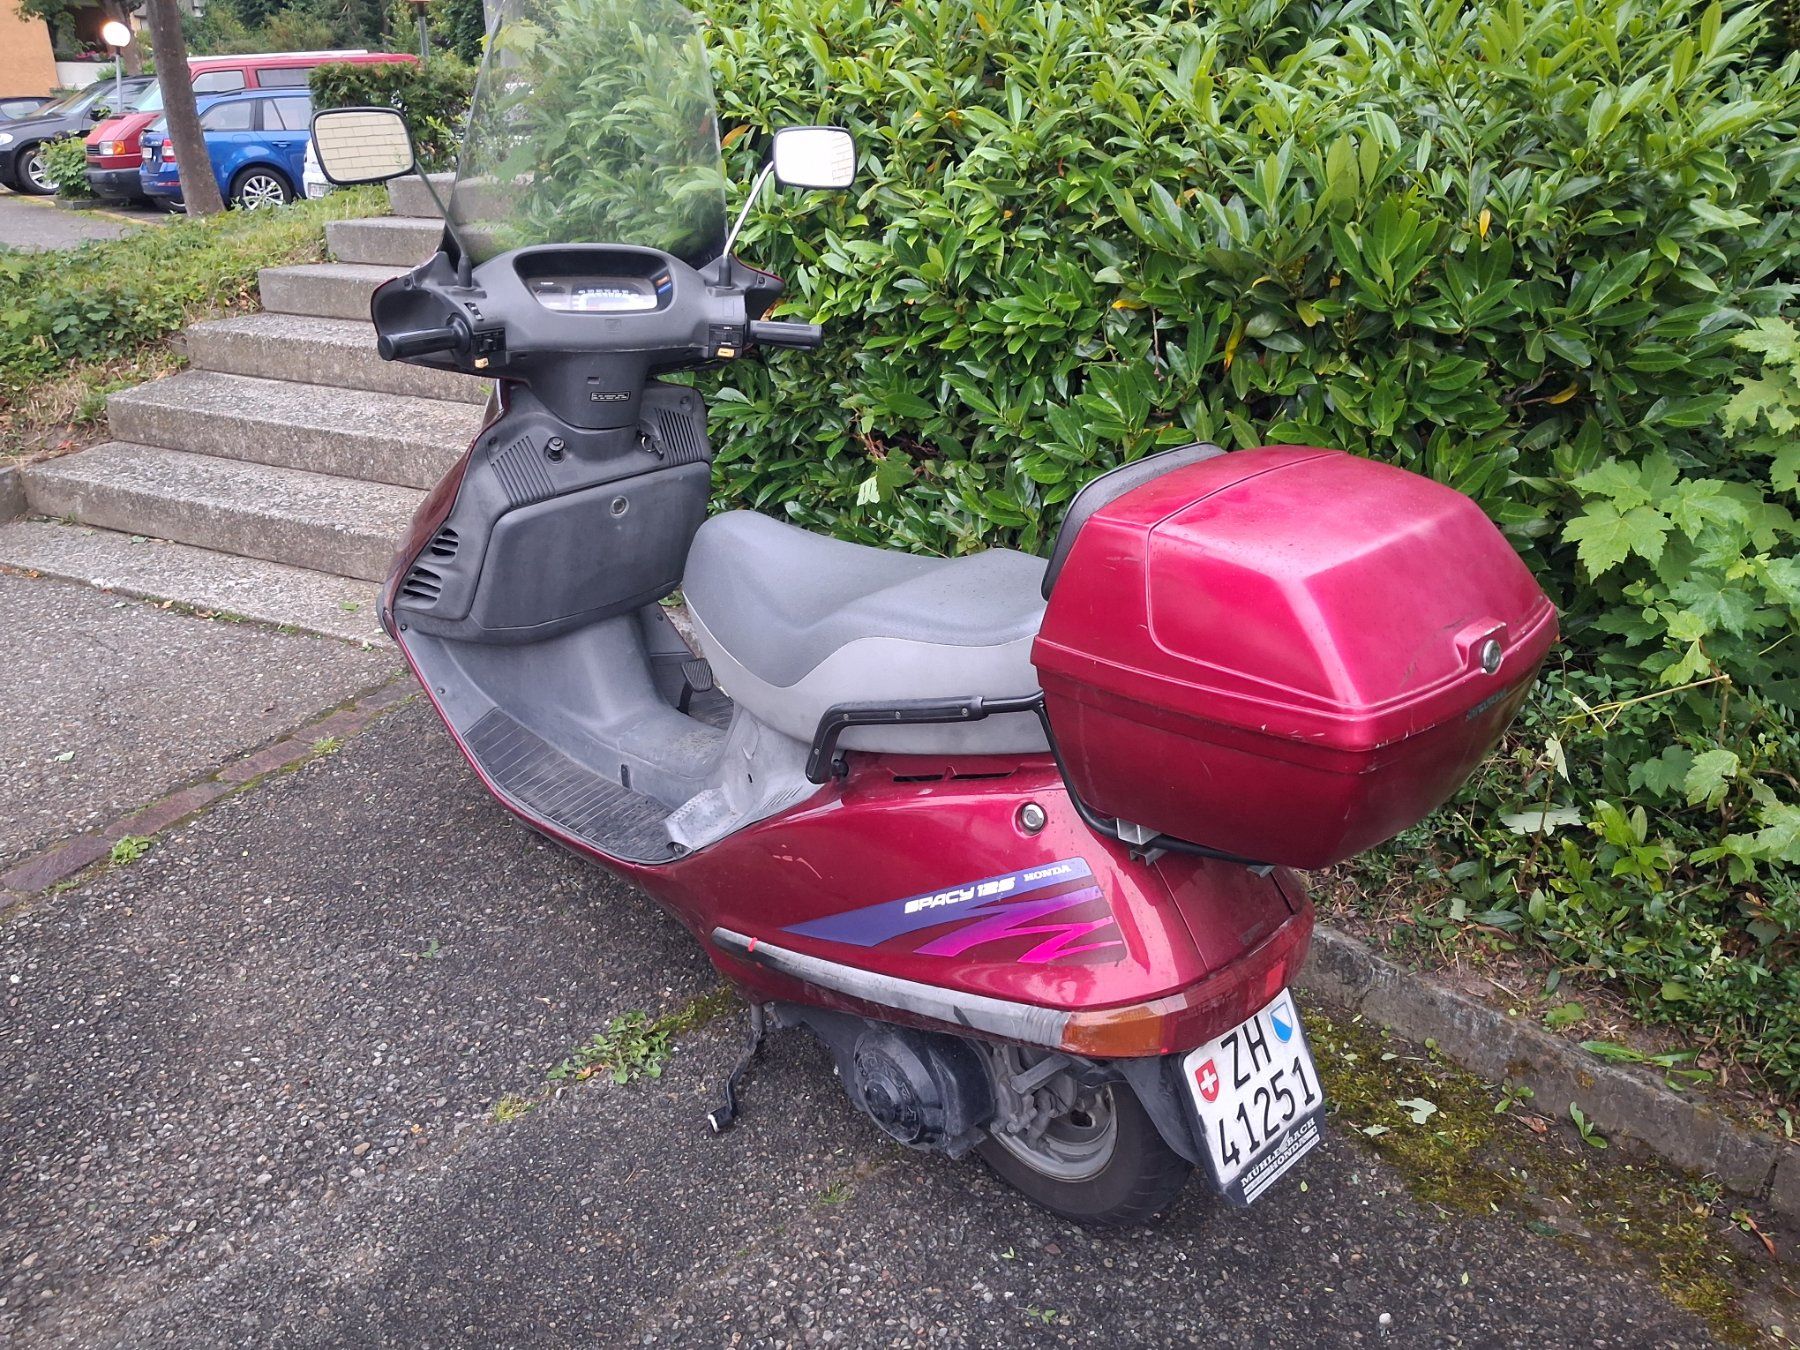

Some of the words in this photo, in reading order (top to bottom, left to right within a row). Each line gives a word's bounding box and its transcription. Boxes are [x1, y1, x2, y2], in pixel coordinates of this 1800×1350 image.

[905, 886, 974, 914] SPACY
[977, 877, 1015, 898] 125
[1023, 864, 1072, 882] HONDA
[1220, 1015, 1272, 1090] ZH
[1219, 1057, 1315, 1167] 41251
[1269, 1140, 1304, 1172] HONDA
